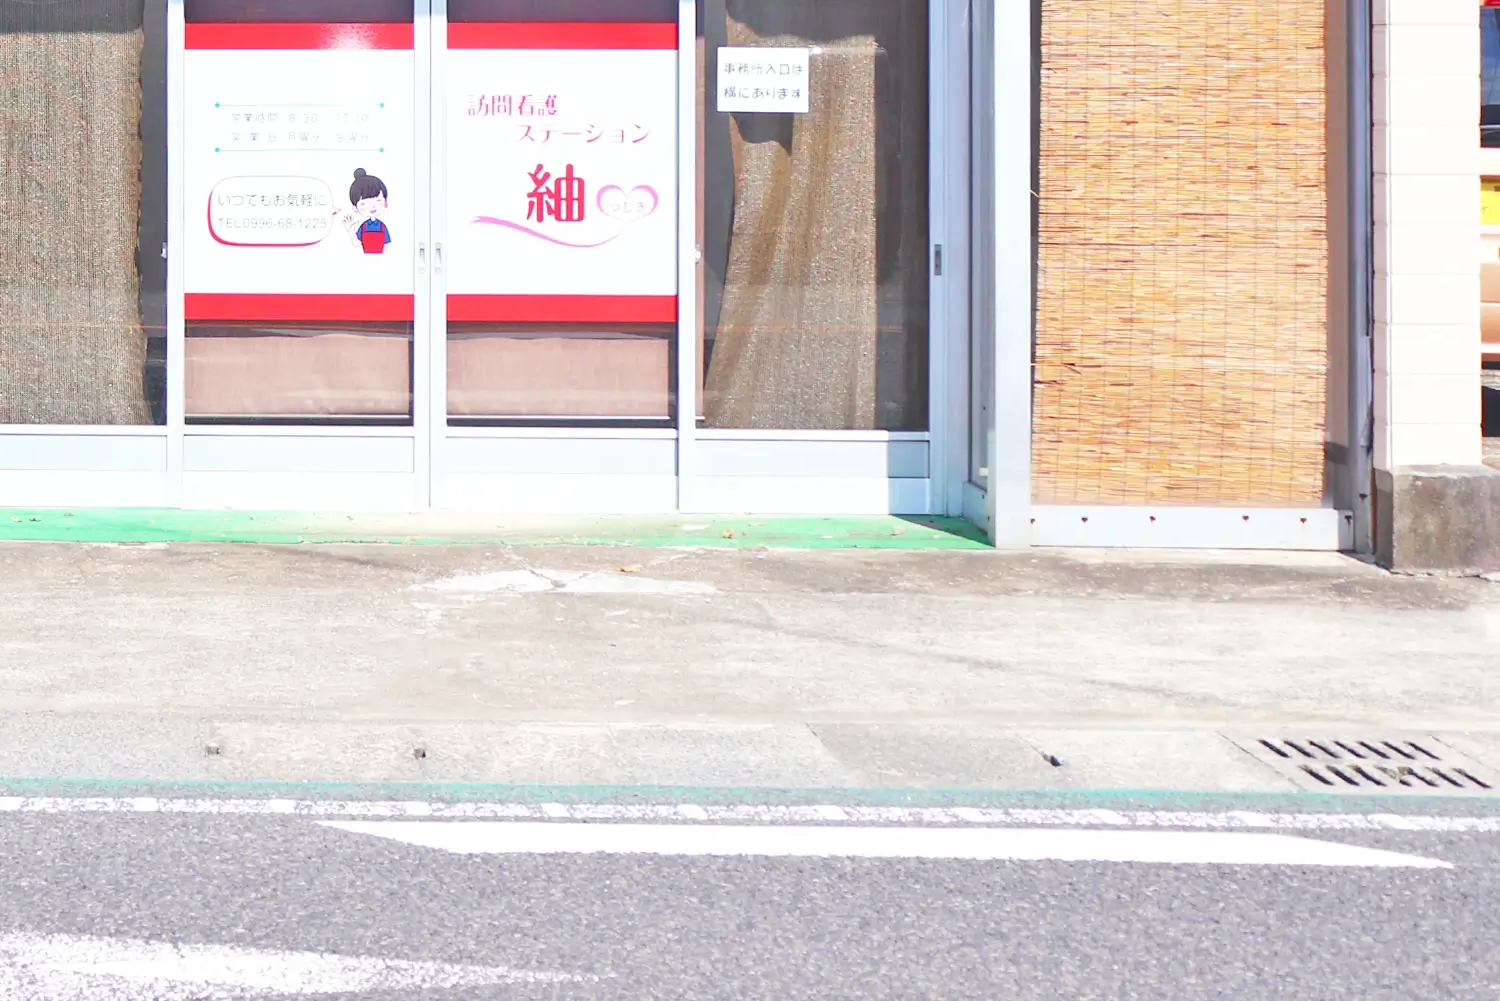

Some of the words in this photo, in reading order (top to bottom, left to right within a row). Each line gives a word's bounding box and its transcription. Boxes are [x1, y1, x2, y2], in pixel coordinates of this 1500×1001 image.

[723, 61, 803, 76] 事務所入口は
[723, 84, 801, 100] 横にあります
[464, 93, 560, 117] 訪問看護
[513, 122, 650, 144] ステーション
[526, 163, 586, 224] 紬
